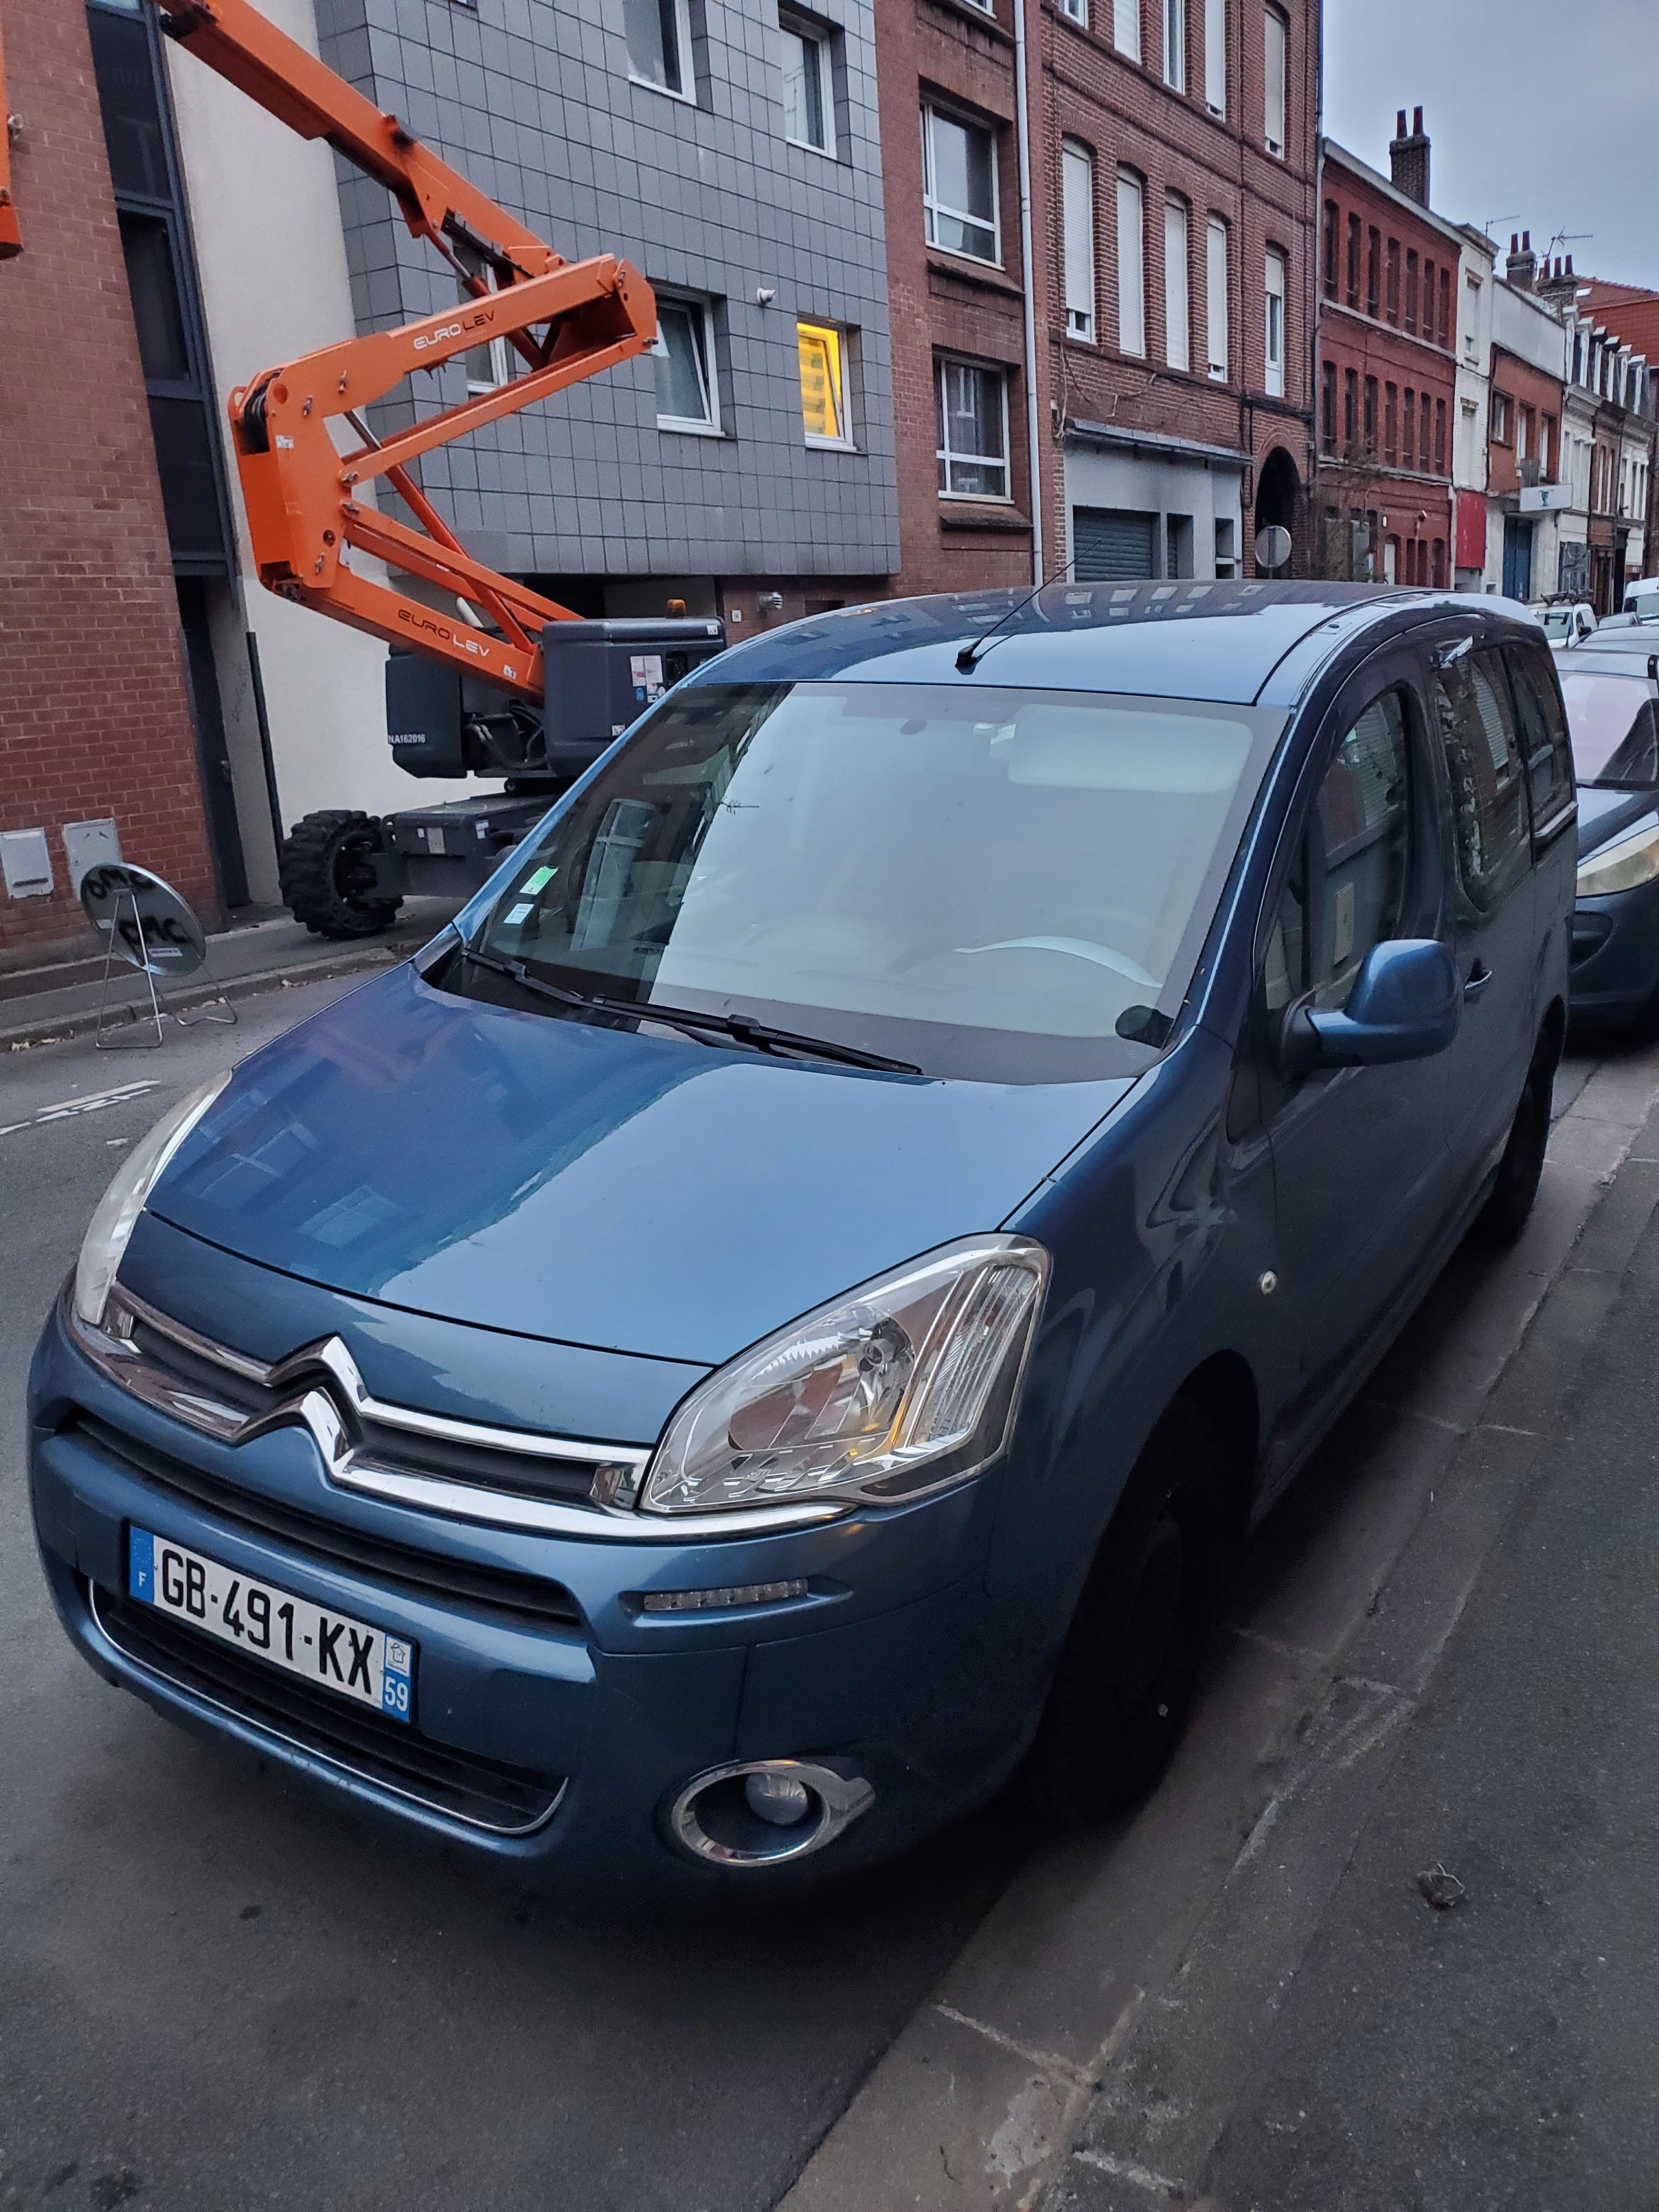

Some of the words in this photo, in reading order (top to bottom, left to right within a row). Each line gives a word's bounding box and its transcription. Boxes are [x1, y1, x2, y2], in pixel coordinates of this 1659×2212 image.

[138, 1571, 147, 1587] F
[162, 1549, 374, 1695] GB-491-KX
[385, 1675, 409, 1712] 59
